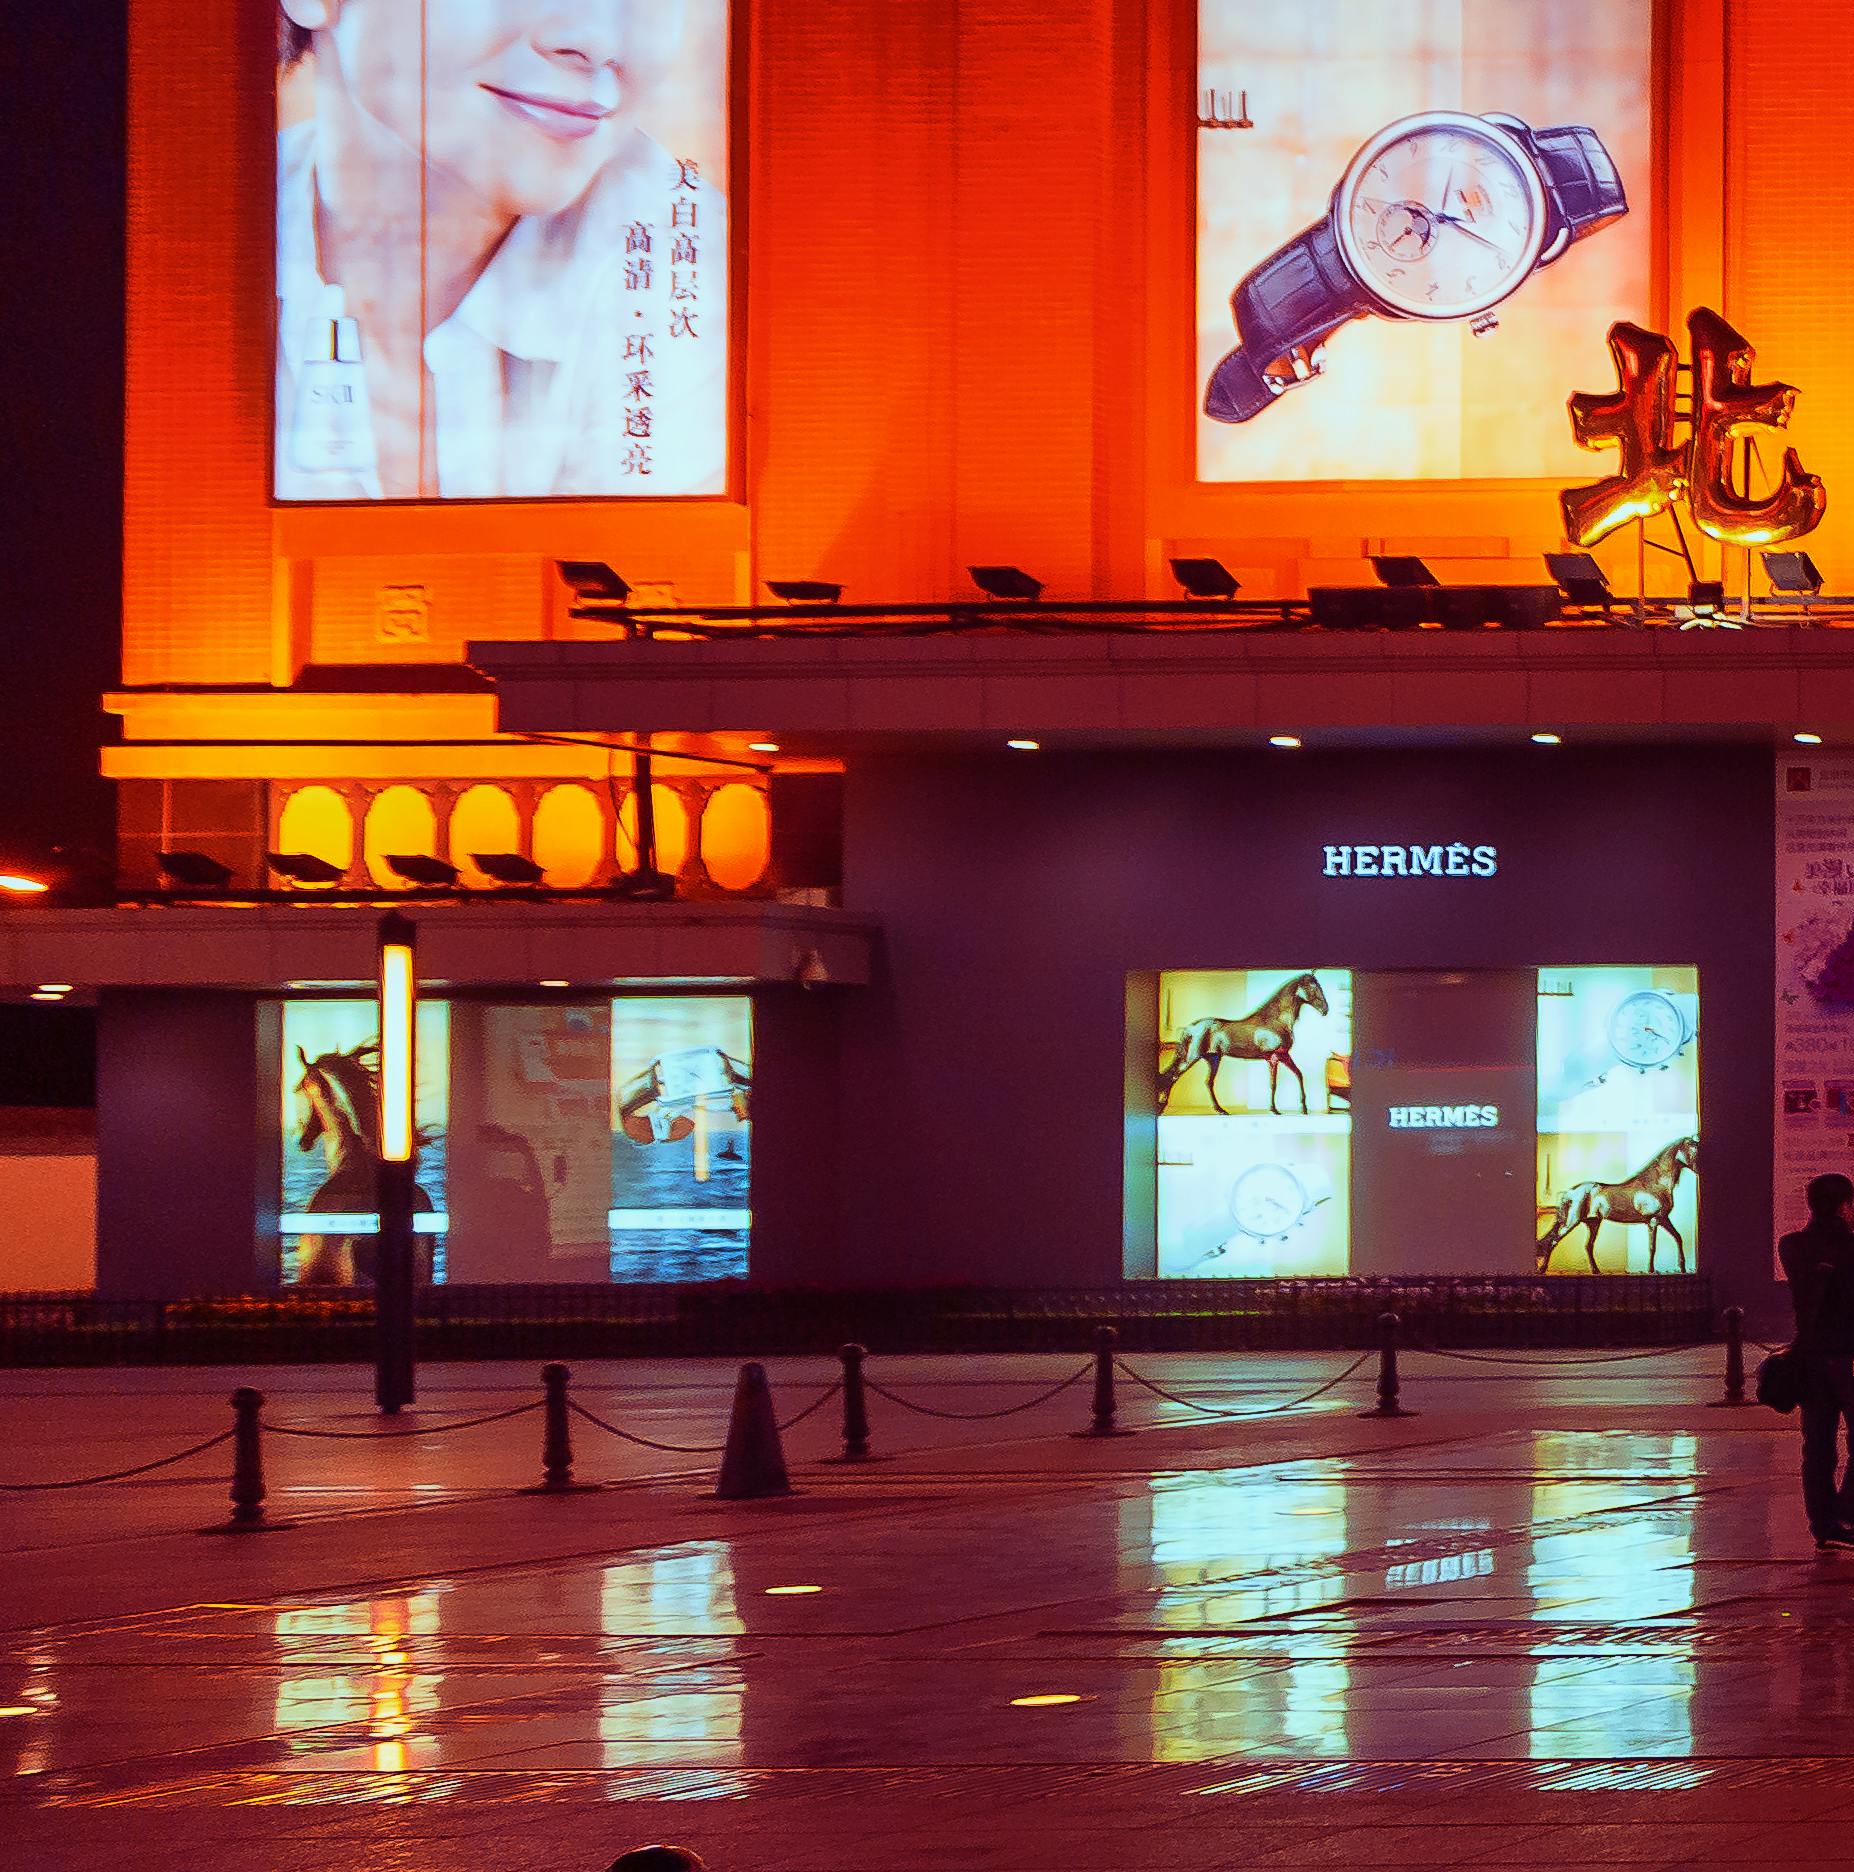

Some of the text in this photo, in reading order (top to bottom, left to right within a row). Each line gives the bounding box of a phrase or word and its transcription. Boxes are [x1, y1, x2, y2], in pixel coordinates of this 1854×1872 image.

[667, 158, 701, 339] 美白高层次
